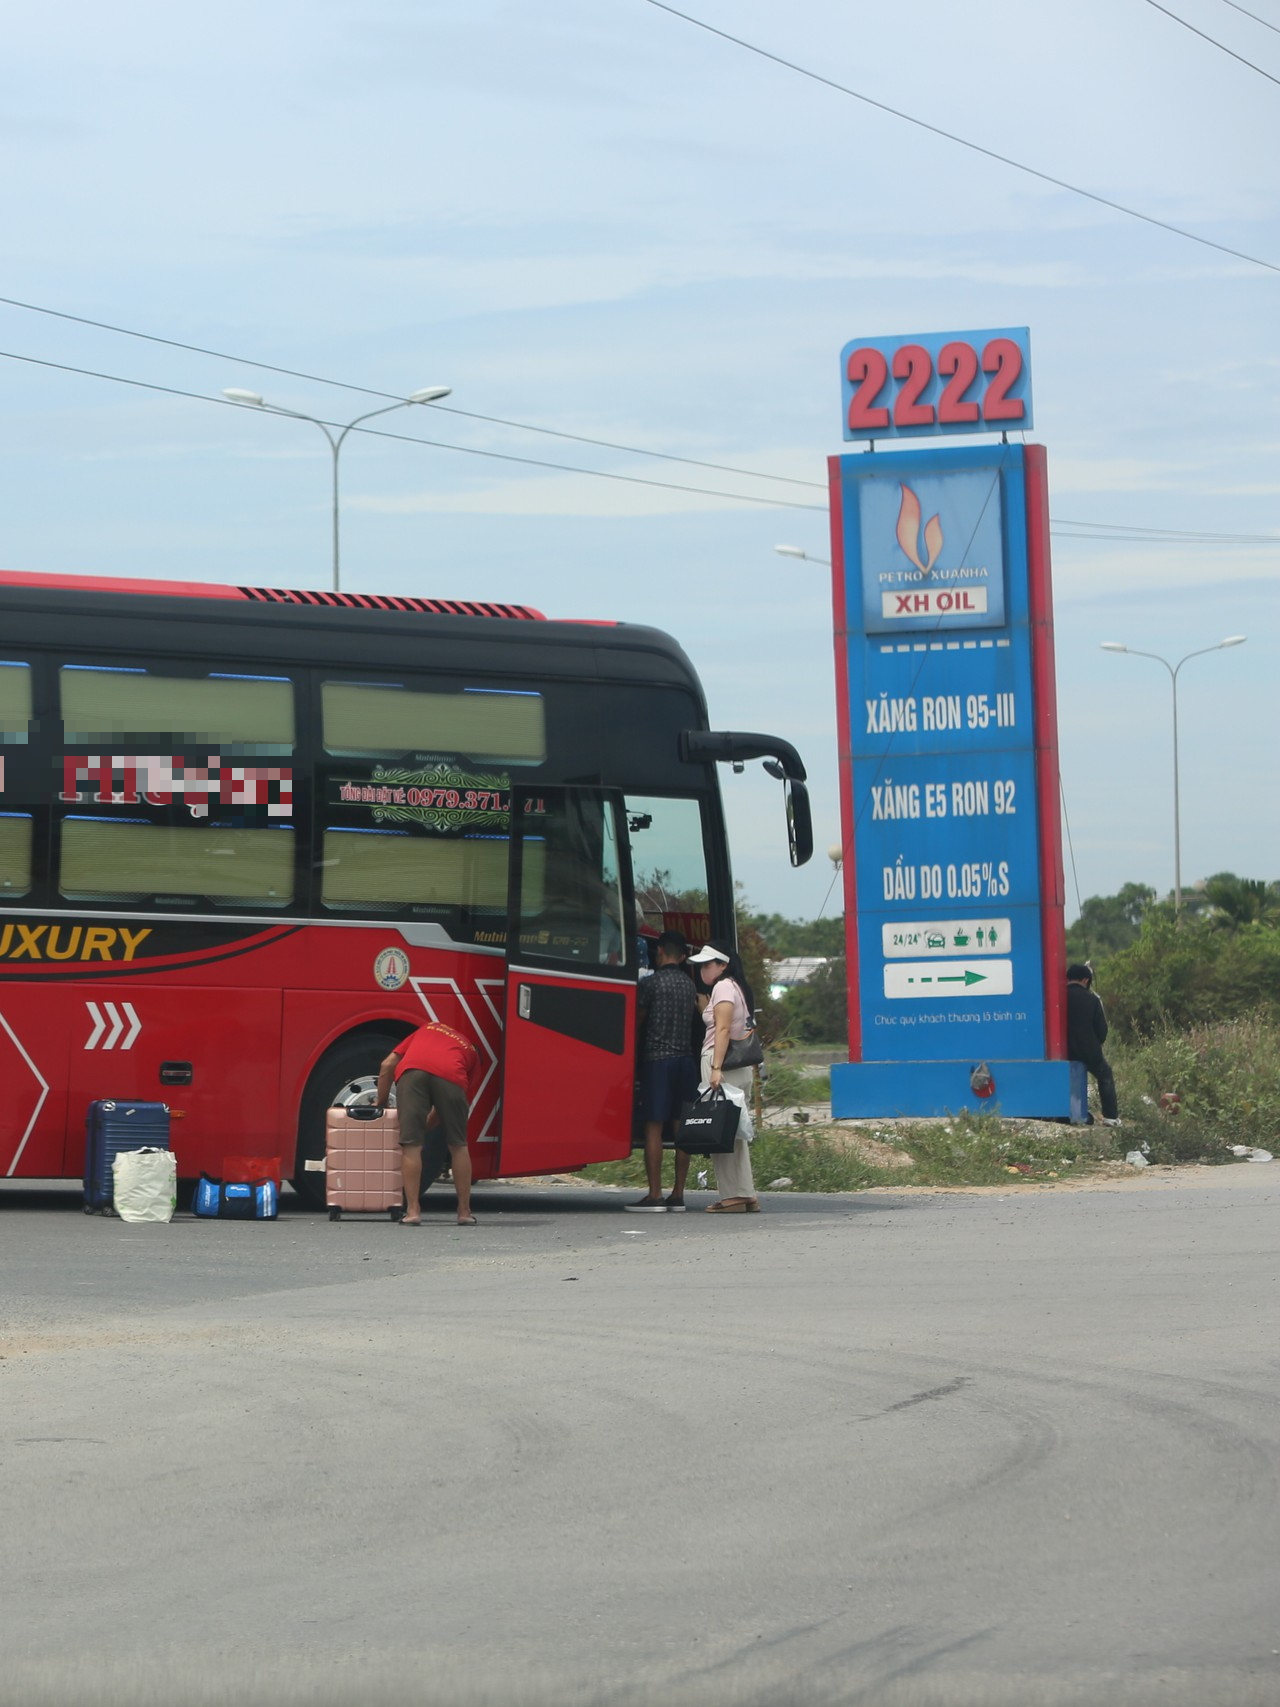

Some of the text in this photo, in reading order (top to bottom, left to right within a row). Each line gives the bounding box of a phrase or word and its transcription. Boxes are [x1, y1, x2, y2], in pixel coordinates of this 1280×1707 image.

[846, 338, 1025, 430] 2222
[879, 567, 989, 583] PETRO XUANHA
[895, 591, 976, 614] XH OIL
[866, 692, 1016, 734] XĂNG RON 95-III
[407, 786, 546, 814] 0979.371.71
[871, 778, 1016, 820] XĂNG E5 RON 92
[883, 854, 916, 901] DẦU
[920, 864, 942, 899] DO
